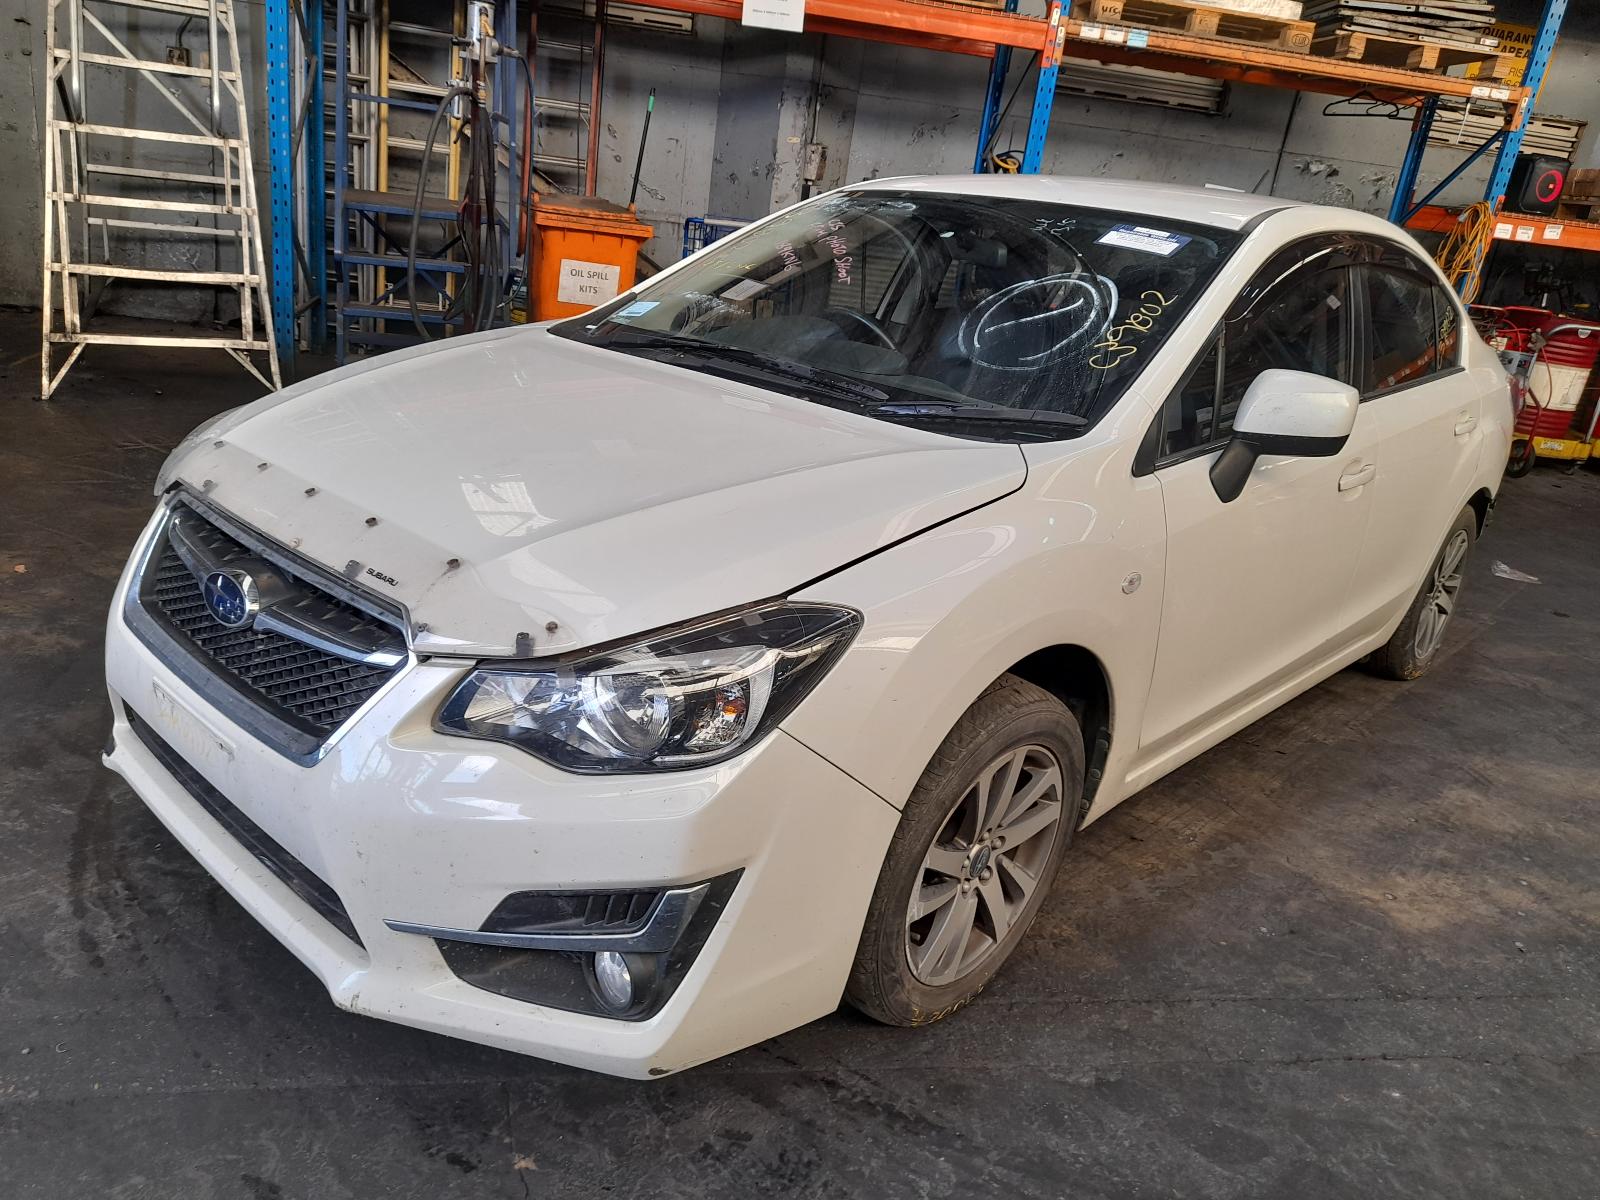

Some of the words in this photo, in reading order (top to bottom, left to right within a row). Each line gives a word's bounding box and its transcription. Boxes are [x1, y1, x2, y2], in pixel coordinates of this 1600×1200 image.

[570, 268, 585, 278] OIL
[587, 270, 609, 281] SPILL
[579, 284, 598, 294] KITS
[366, 567, 399, 587] SUBARU
